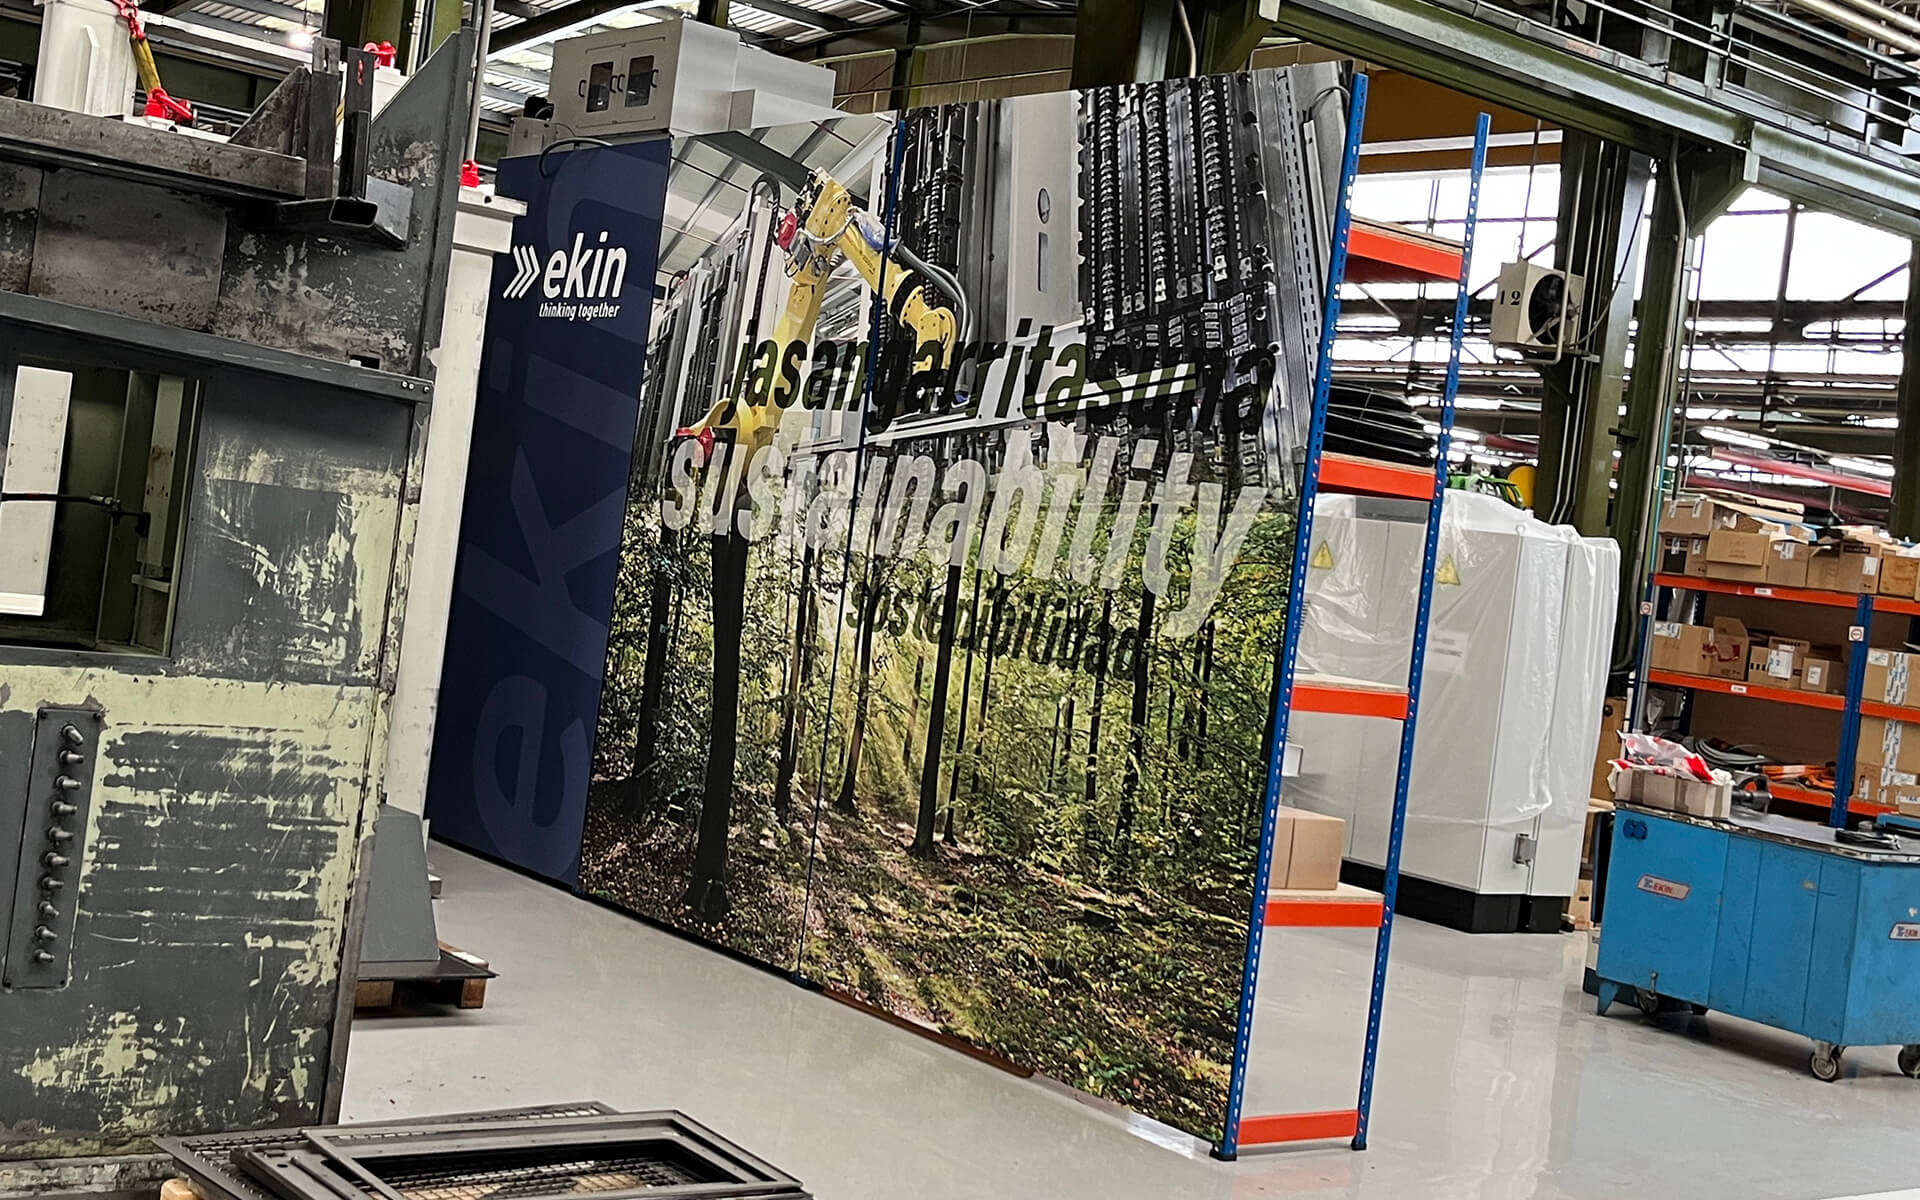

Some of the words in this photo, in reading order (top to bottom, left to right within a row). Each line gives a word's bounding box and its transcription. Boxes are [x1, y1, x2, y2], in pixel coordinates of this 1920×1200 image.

[543, 231, 627, 298] ekin
[539, 303, 575, 321] thinking
[578, 302, 620, 321] together
[1499, 290, 1521, 306] 12
[661, 427, 1268, 638] sustainability
